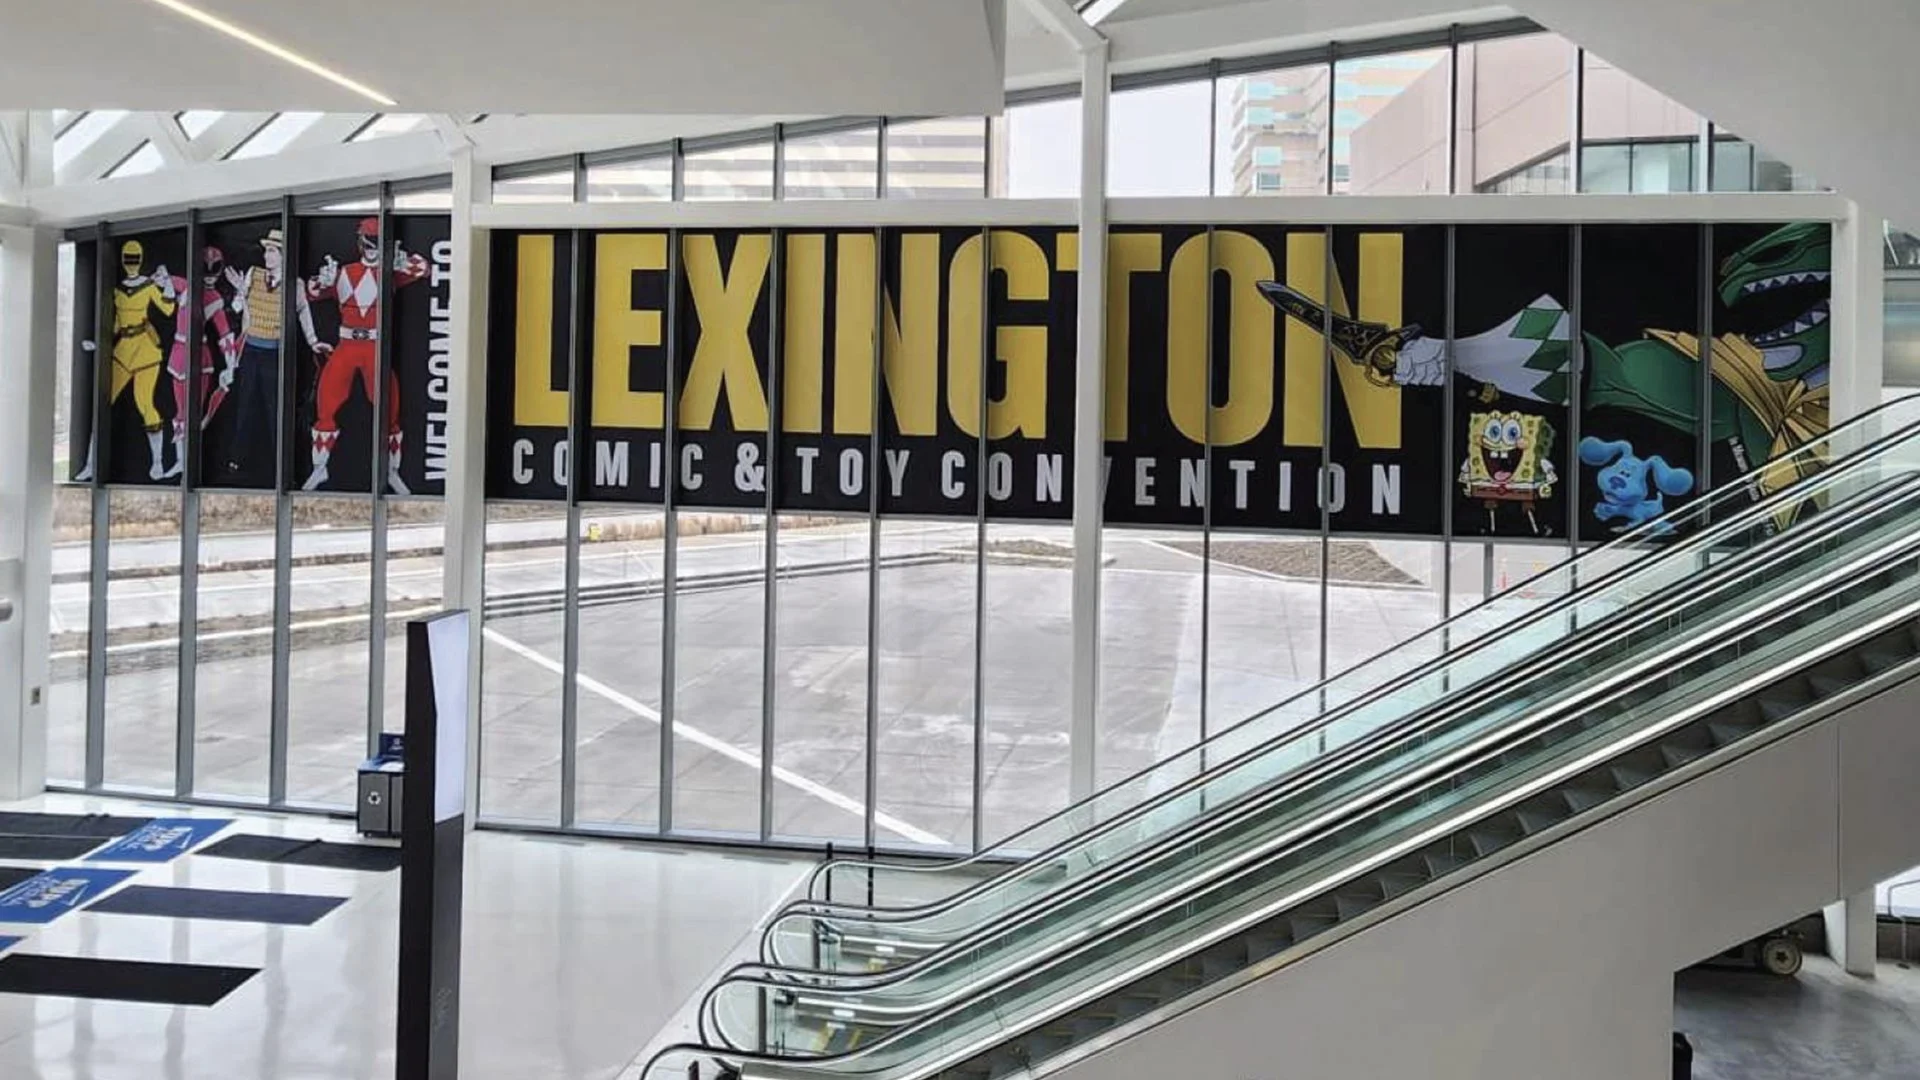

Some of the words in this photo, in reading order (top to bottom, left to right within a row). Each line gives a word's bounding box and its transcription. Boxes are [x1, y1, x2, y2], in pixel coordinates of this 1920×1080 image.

[513, 231, 1403, 449] LEXINGTON
[512, 438, 703, 491] COMIC
[734, 442, 766, 492] &
[796, 447, 910, 497] TOY
